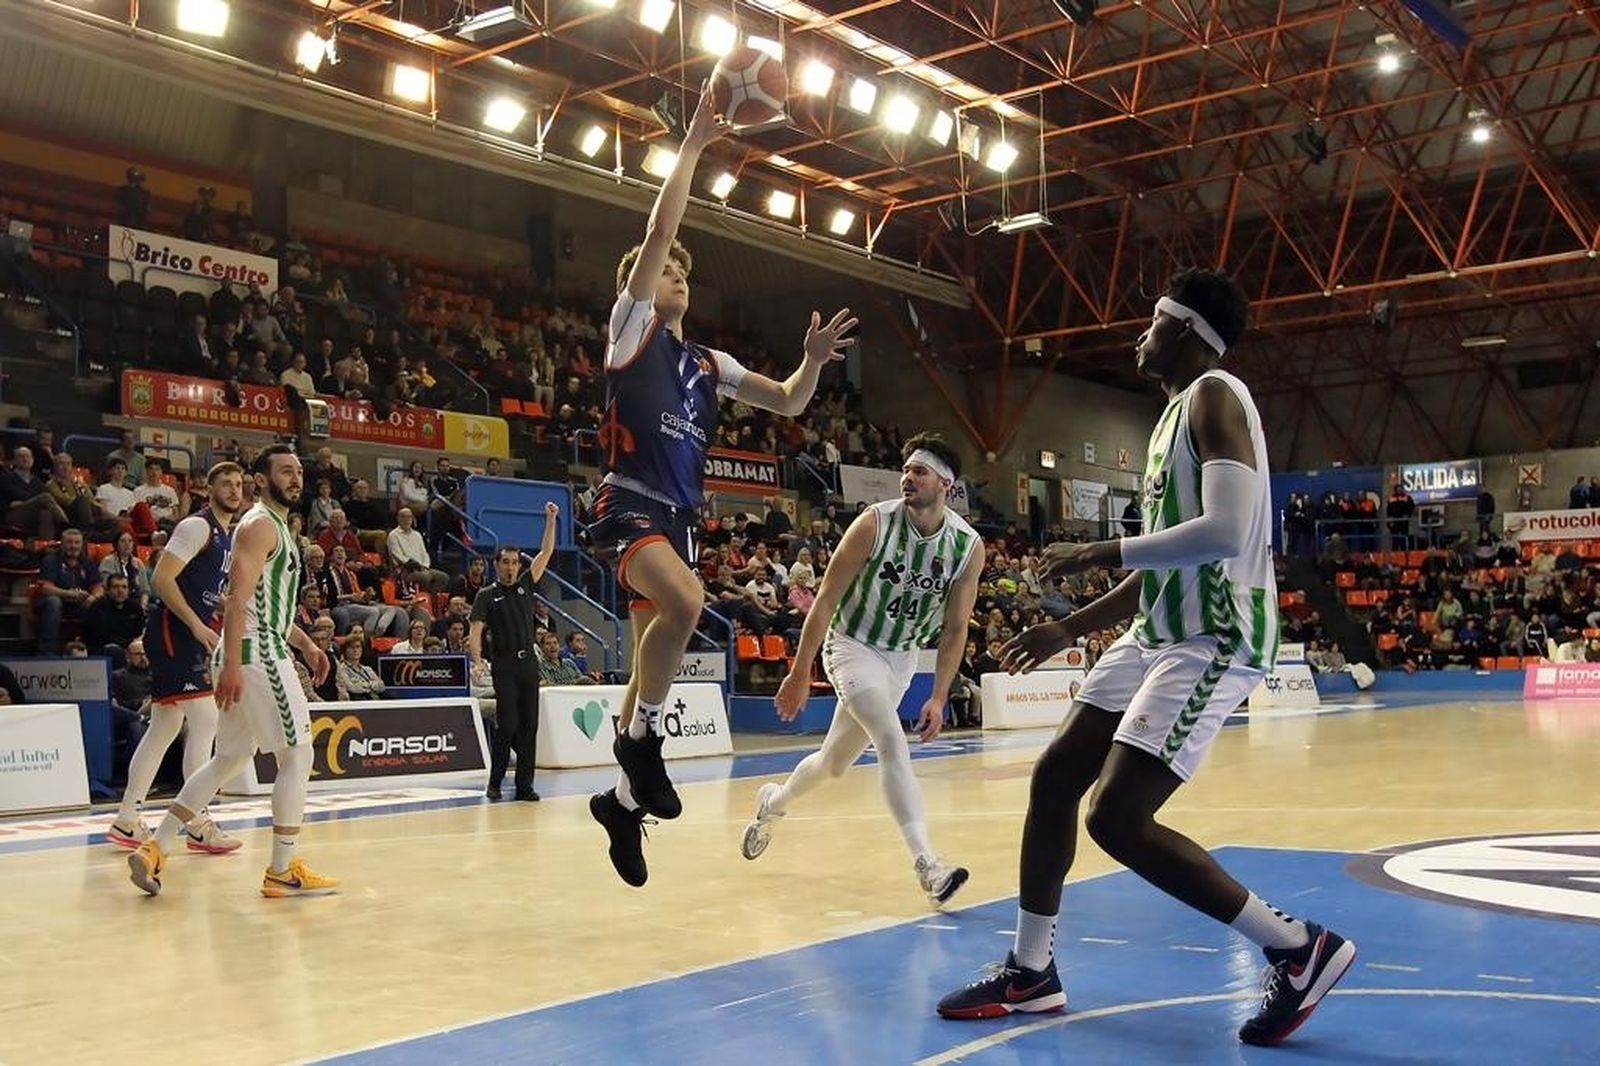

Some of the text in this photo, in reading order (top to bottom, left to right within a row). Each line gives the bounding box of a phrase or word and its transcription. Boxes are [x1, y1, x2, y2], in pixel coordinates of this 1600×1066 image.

[134, 243, 269, 286] Brico Centro
[1403, 467, 1459, 492] SALIDA
[886, 596, 918, 620] 44
[683, 719, 716, 737] salud
[349, 734, 456, 757] NORSOL
